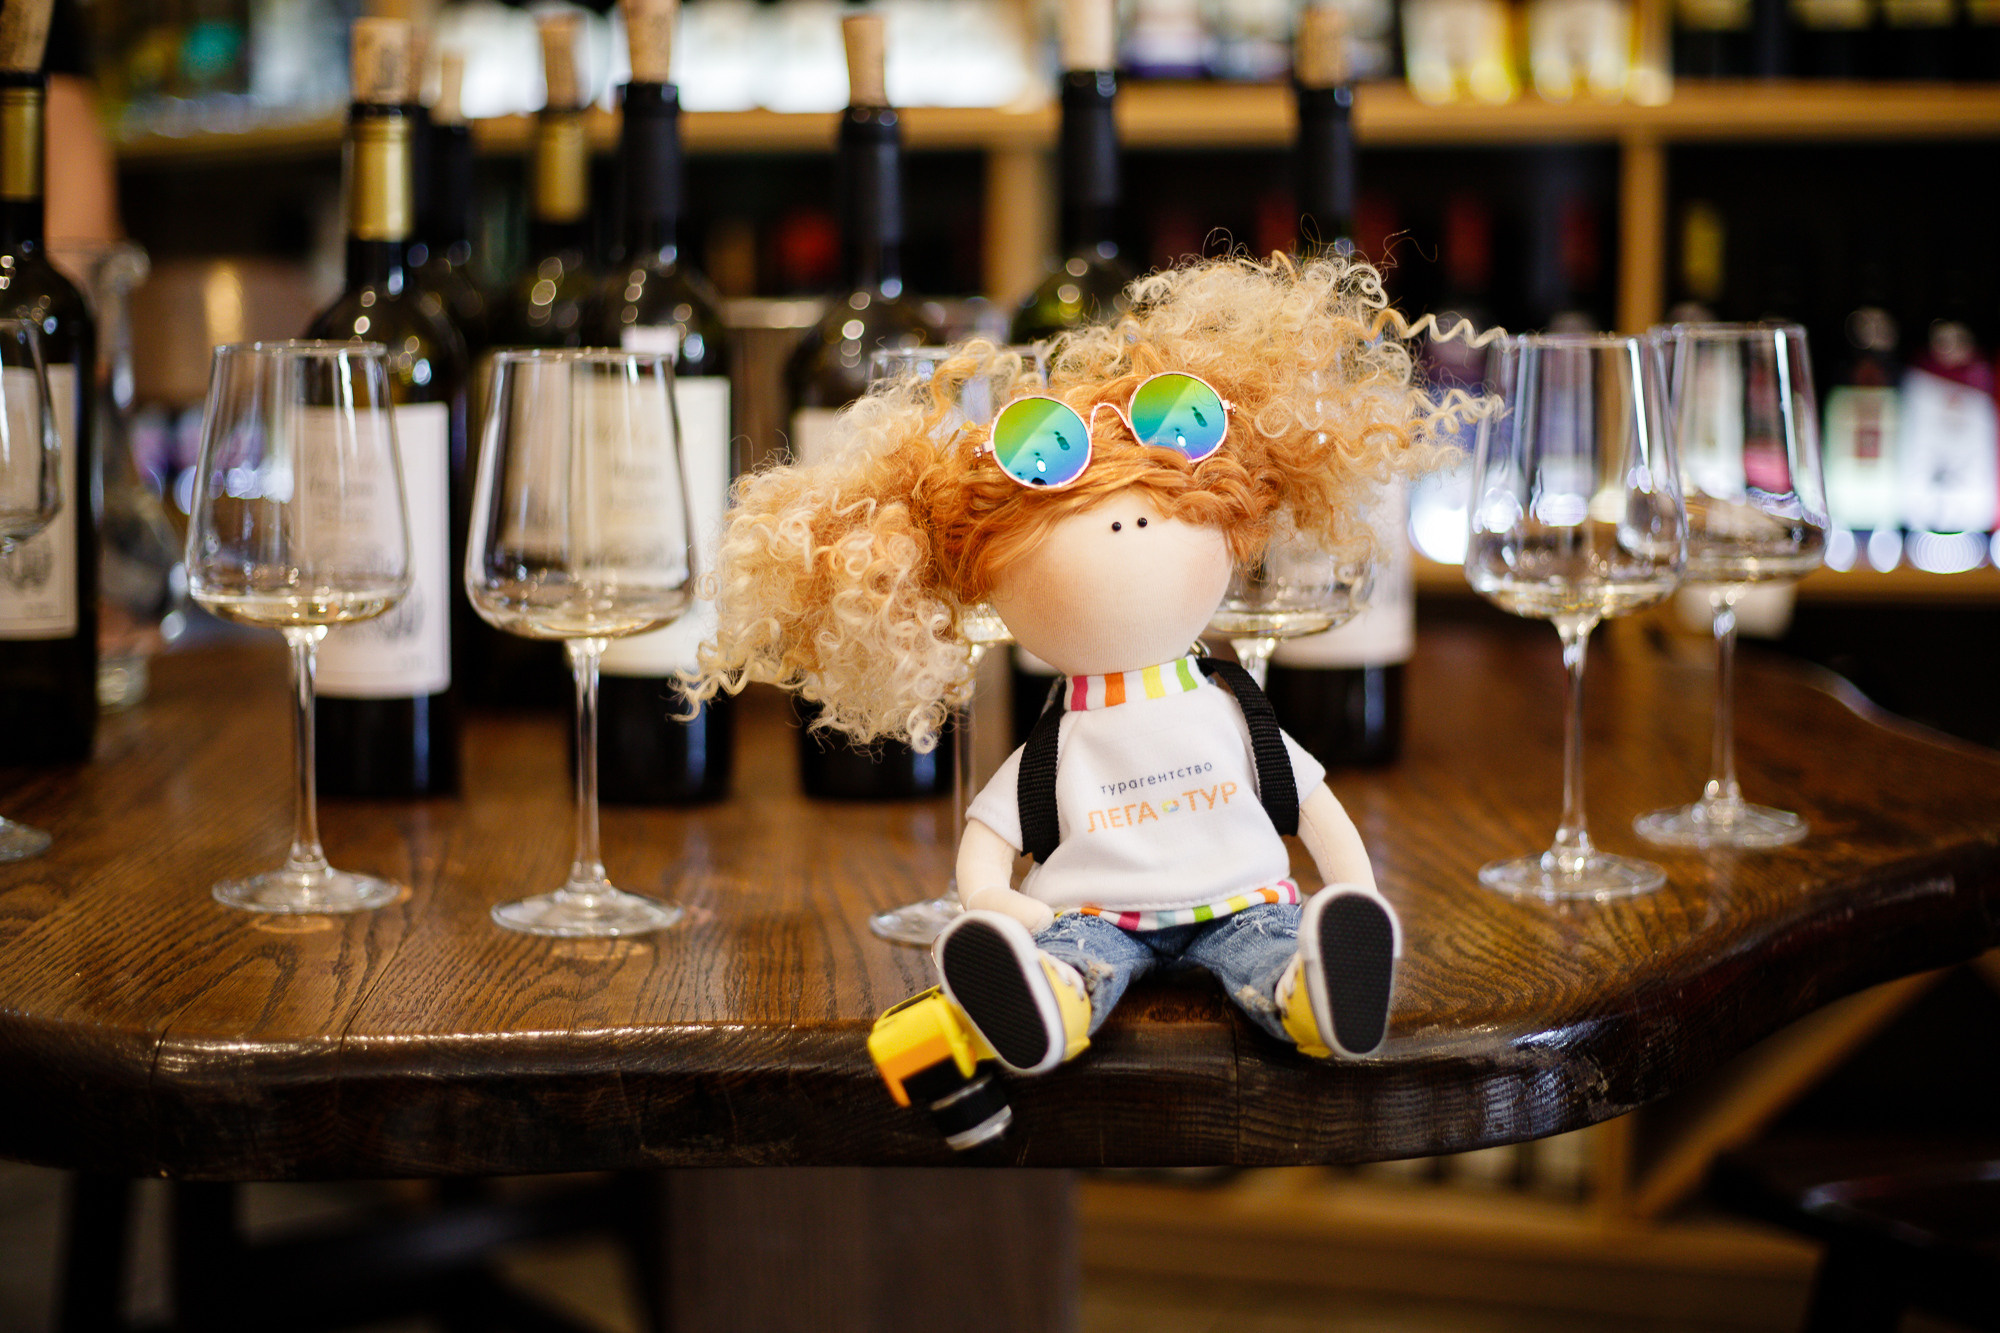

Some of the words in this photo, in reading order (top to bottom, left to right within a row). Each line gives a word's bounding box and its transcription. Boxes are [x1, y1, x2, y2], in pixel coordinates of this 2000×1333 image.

[1100, 761, 1213, 796] турагентство
[1087, 801, 1159, 833] ЛЕГА
[1181, 781, 1238, 811] ТУР
